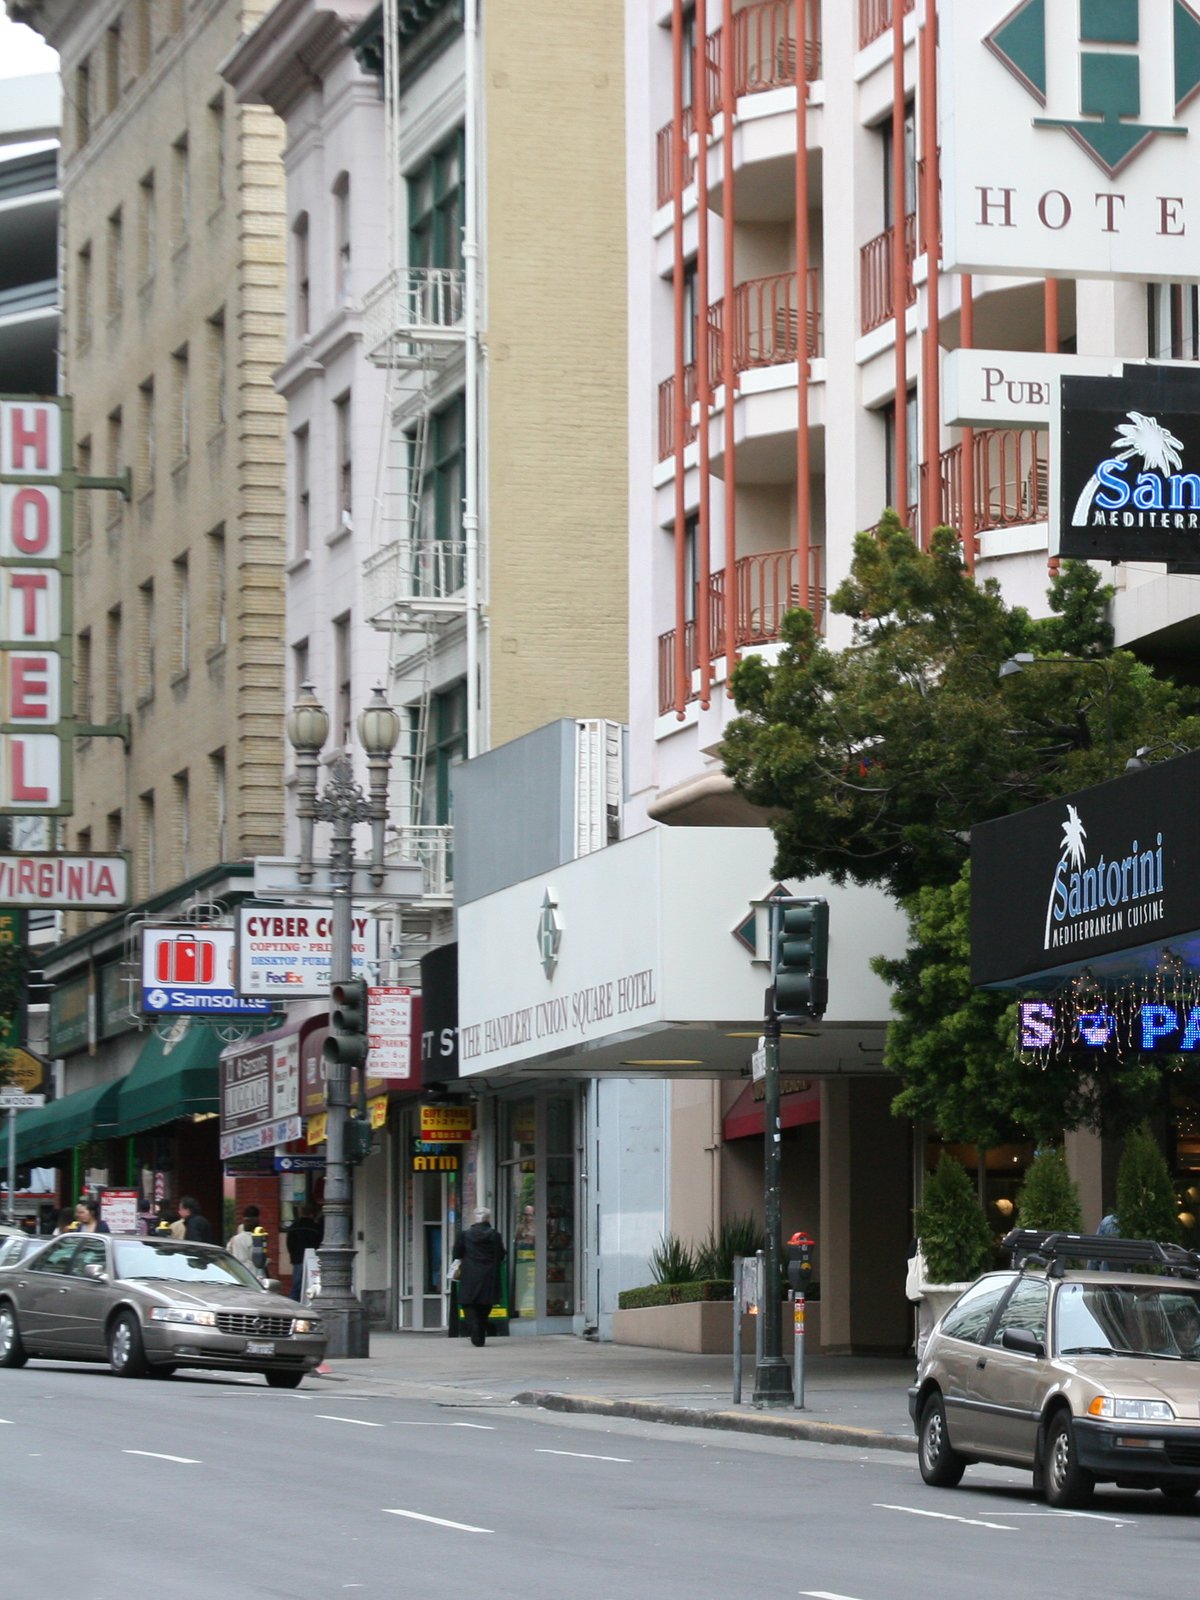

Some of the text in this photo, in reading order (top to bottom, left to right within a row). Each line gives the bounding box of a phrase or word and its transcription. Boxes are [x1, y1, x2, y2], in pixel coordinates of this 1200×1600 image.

[10, 408, 49, 802] HOTEL
[0, 859, 117, 901] IRGINIA
[1053, 832, 1164, 922] Santorini
[246, 916, 369, 939] CYBER CY
[1052, 899, 1164, 948] MEDITERRANEAN CUISINE
[250, 942, 365, 953] COPYING PRING
[251, 956, 298, 967] DESKTOP
[265, 971, 304, 984] FedEx
[461, 969, 656, 1061] THE HANDLERY UNION SQUARE HOTEL
[440, 1027, 459, 1057] S
[413, 1155, 458, 1171] ATM
